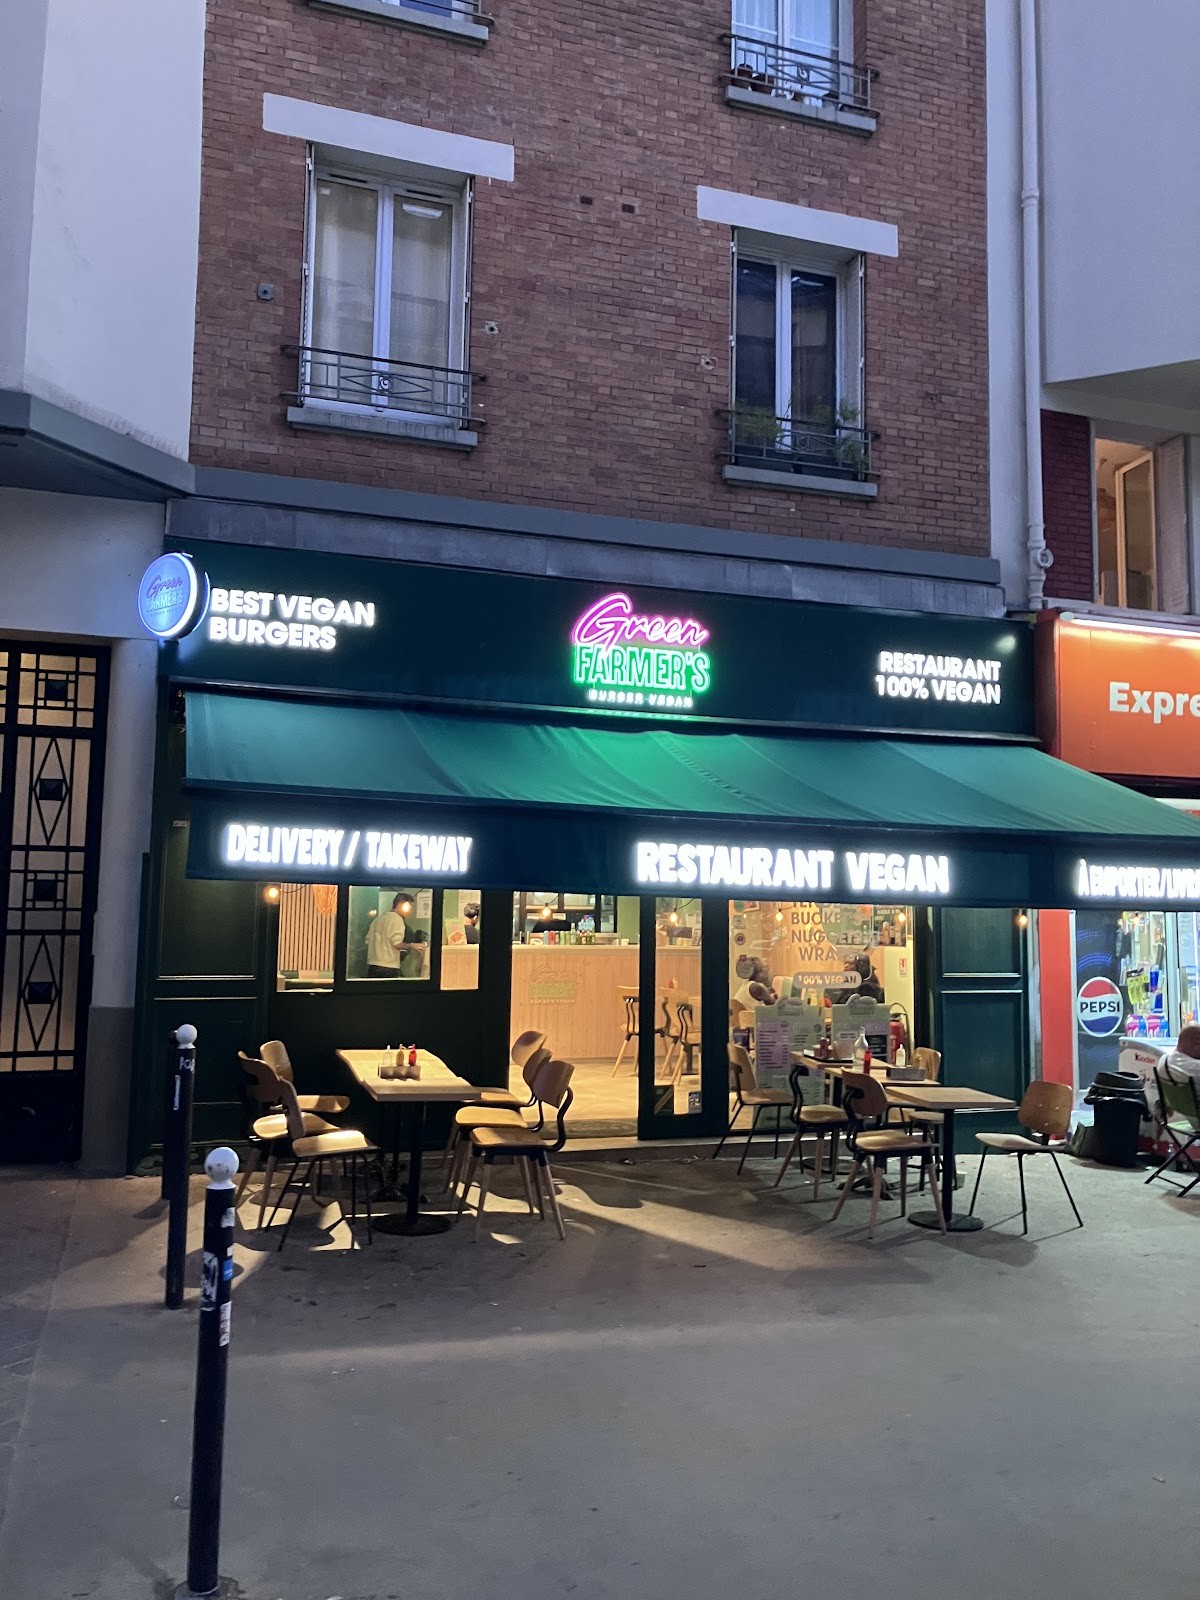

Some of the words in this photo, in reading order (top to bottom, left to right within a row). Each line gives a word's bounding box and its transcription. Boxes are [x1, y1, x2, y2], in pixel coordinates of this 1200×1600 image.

[210, 587, 274, 616] BEST
[277, 594, 375, 627] VEGAN
[573, 592, 709, 658] Green
[209, 617, 337, 650] BURGERS
[574, 643, 711, 692] FARMER'S
[879, 650, 1002, 682] RESTAURANT
[875, 674, 930, 699] 100%
[931, 679, 1001, 705] VEGAN
[1108, 681, 1200, 724] Expre
[226, 824, 344, 866] DELIVERY
[366, 831, 473, 872] TAKEWAY
[636, 841, 835, 888] RESTAURANT
[845, 851, 950, 893] VEGAN
[1080, 1001, 1120, 1013] PEPSI
